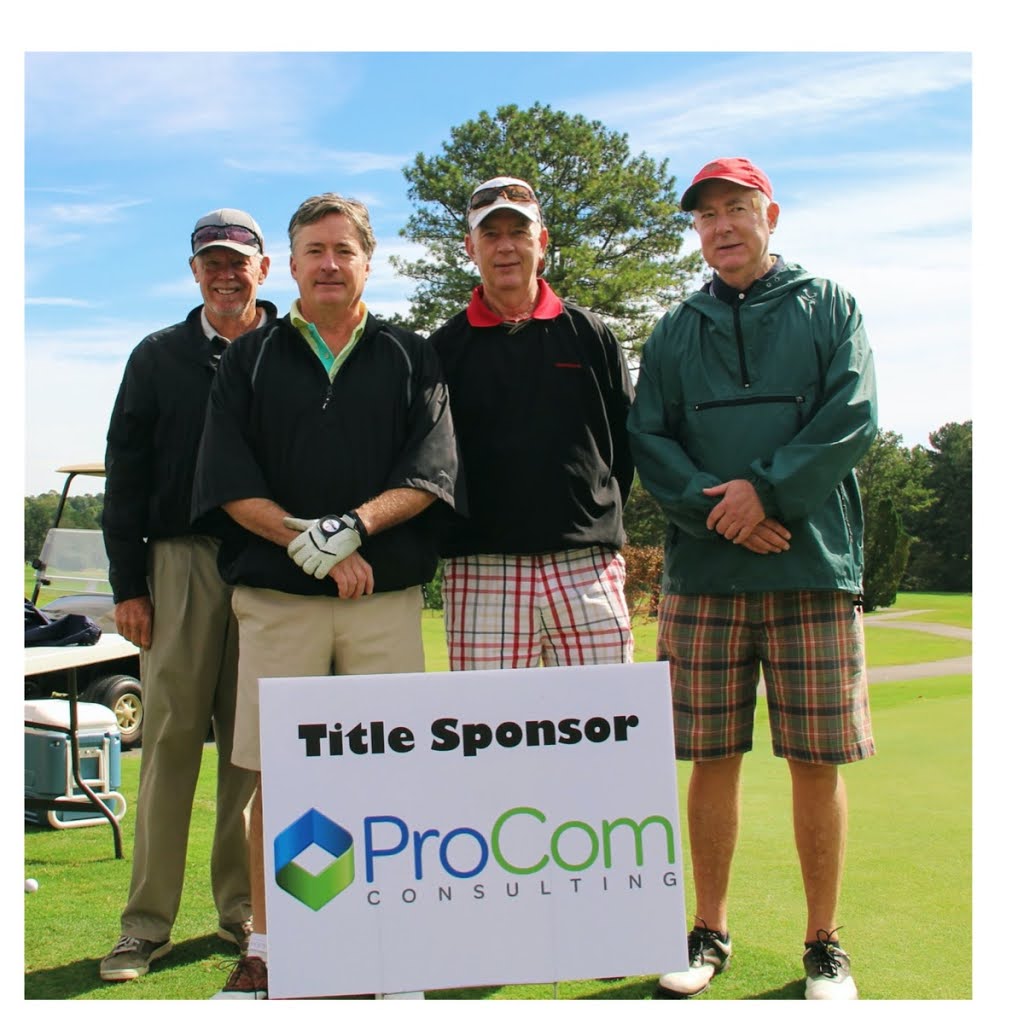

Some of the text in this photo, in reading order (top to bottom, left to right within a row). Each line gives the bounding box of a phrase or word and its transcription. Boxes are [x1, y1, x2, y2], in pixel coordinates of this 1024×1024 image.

[298, 715, 640, 757] Title Sponsor
[363, 807, 676, 883] ProCom
[367, 872, 677, 906] CONSULTING
